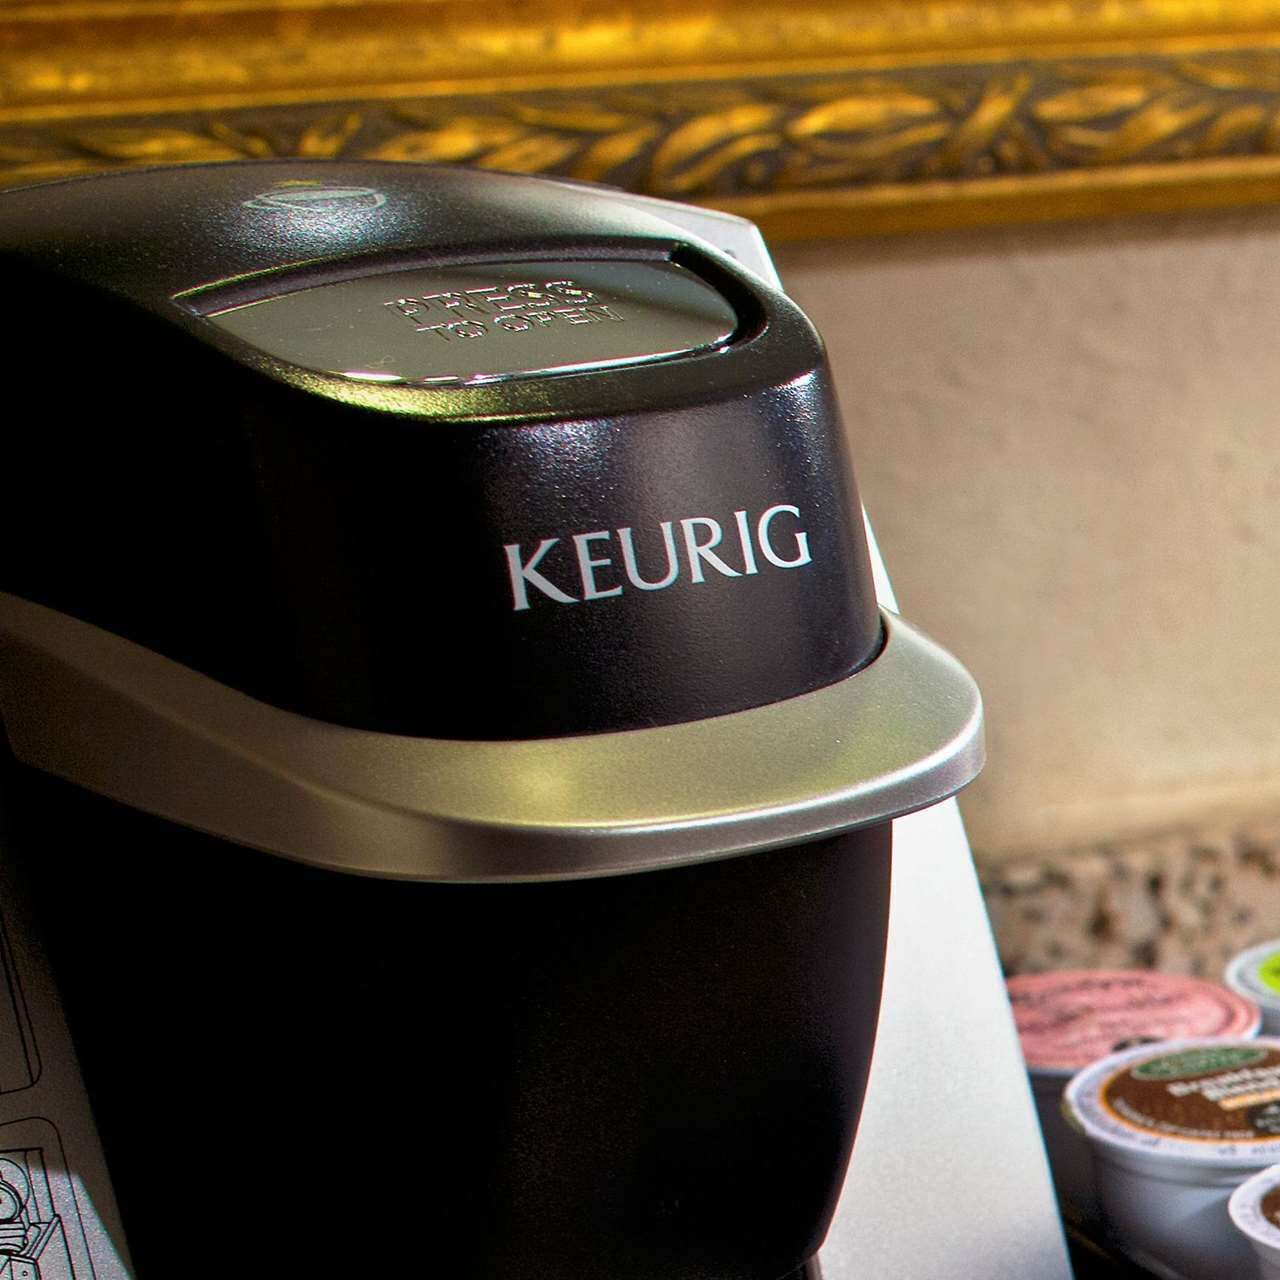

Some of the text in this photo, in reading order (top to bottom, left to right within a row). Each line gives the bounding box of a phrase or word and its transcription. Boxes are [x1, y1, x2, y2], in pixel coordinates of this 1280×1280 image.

[384, 280, 598, 325] PRESS
[416, 304, 625, 341] TO OPEN
[504, 504, 813, 611] KEURIG
